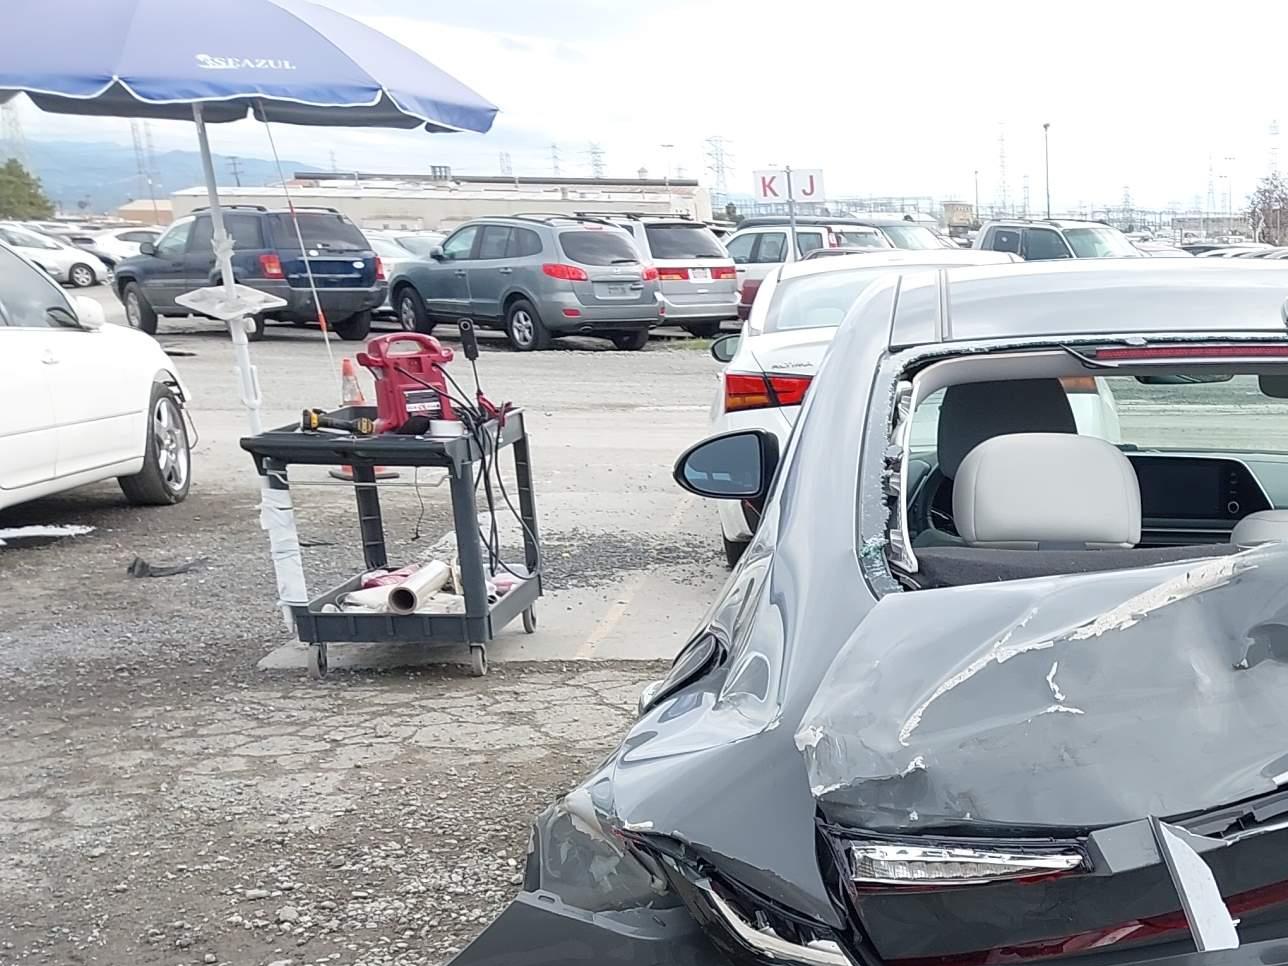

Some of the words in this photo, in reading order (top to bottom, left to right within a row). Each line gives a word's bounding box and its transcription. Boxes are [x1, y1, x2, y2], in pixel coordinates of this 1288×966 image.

[208, 57, 296, 69] SEAZUL
[761, 176, 779, 197] K
[802, 175, 814, 196] J
